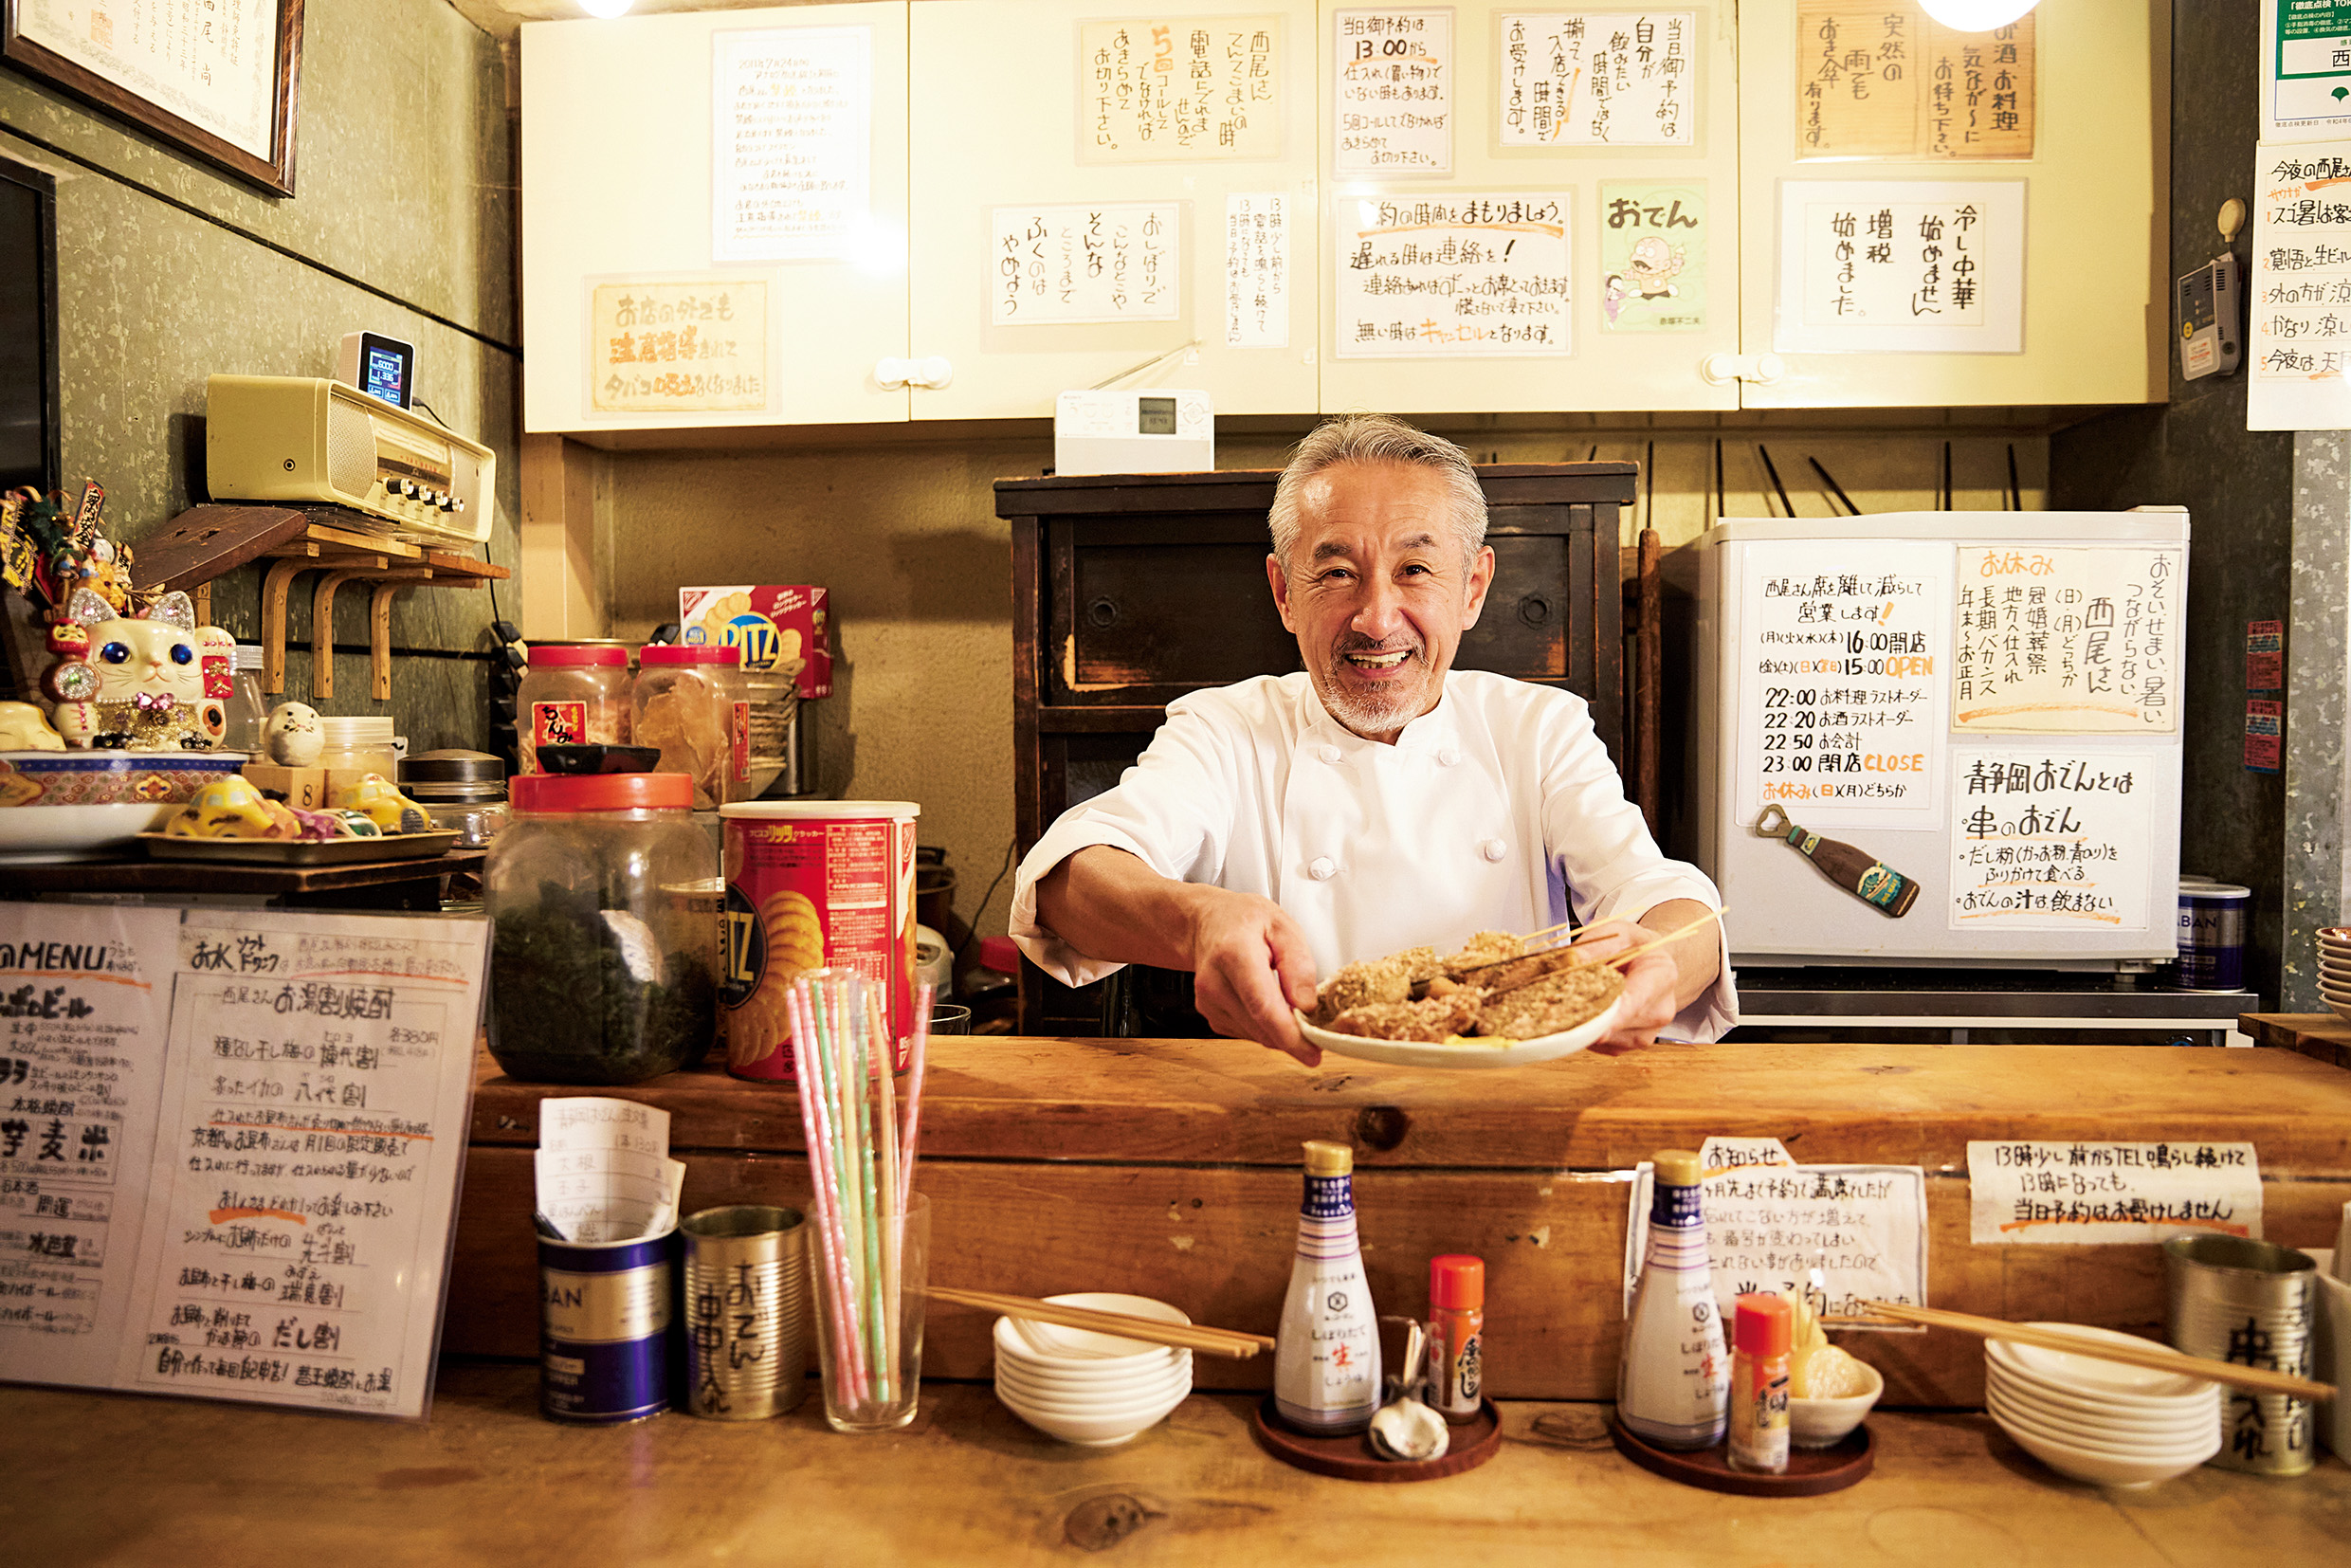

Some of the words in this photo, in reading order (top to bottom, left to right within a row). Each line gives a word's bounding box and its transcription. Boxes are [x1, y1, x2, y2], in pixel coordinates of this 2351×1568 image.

[1113, 27, 1134, 111] あきらめて
[1609, 30, 1631, 92] 飲みたい
[1817, 16, 1845, 89] おき傘
[1844, 48, 1875, 100] 雨でも
[2331, 49, 2351, 68] 西
[1094, 46, 1119, 151] お切り下さい。
[1151, 24, 1175, 131] 5回コールして
[1506, 19, 1528, 135] お受けします。
[1548, 34, 1570, 119] 入店できる
[1591, 50, 1613, 142] 時間ではなく
[1533, 80, 1552, 142] 時間で
[1804, 81, 1831, 149] 有ります。
[1930, 55, 1957, 158] お待ち下さい。
[1341, 137, 1388, 151] あきらめて
[1371, 150, 1437, 167] お切り下さい。
[2270, 157, 2351, 182] 今夜の西尾さ
[1370, 200, 1564, 227] 約の時間をまもりましょう。
[1607, 197, 1699, 228] おでん
[1027, 216, 1048, 297] ふくのは
[1084, 211, 1105, 279] そんな
[1139, 211, 1168, 304] おしぼりで
[1866, 208, 1896, 264] 増税
[1951, 204, 1977, 310] 冷し中華
[1000, 234, 1020, 317] やめよう
[1112, 225, 1128, 311] こんなとこや
[1830, 211, 1866, 317] 始めました。
[1911, 213, 1945, 318] 始めません
[615, 292, 735, 328] お店の外でも
[1355, 318, 1555, 346] 無い時はキャンセルとなります。
[609, 324, 738, 365] 注意指導されて
[1979, 550, 2055, 577] お休み
[720, 623, 778, 669] RITZ
[1976, 585, 1998, 696] 長期バカンス
[2001, 585, 2023, 684] 地方へ仕入れ
[2025, 586, 2050, 675] 冠婚葬祭
[2085, 596, 2116, 694] 西尾さん
[1844, 657, 1885, 676] 15:00
[1884, 655, 1934, 679] OPEN
[1763, 687, 1817, 708] 22:00
[1763, 710, 1816, 729] 22:20
[1762, 755, 1813, 773] 23:00
[1863, 753, 1924, 772] CLOSE
[1763, 733, 1813, 751] 22:50
[1818, 731, 1863, 751] お会計
[1963, 758, 2135, 795] 静岡おでんとは
[2178, 914, 2217, 928] BAN
[727, 909, 756, 983] TZ
[221, 985, 273, 1007] 西尾さん
[273, 982, 395, 1021] お湯割焼酎
[9, 1096, 76, 1118] 本格焼酎
[294, 1081, 368, 1108] 八代割
[1, 1118, 30, 1158] 芋
[38, 1117, 68, 1162] 麦
[78, 1123, 112, 1162] 米
[1707, 1143, 1780, 1168] お知らせ
[36, 1194, 74, 1220] 開運
[2014, 1198, 2234, 1224] 当日予約はお受けしません
[550, 1286, 583, 1309] AN
[725, 1260, 766, 1370] おでん
[274, 1315, 339, 1352] だし割
[1332, 1341, 1355, 1368] 生
